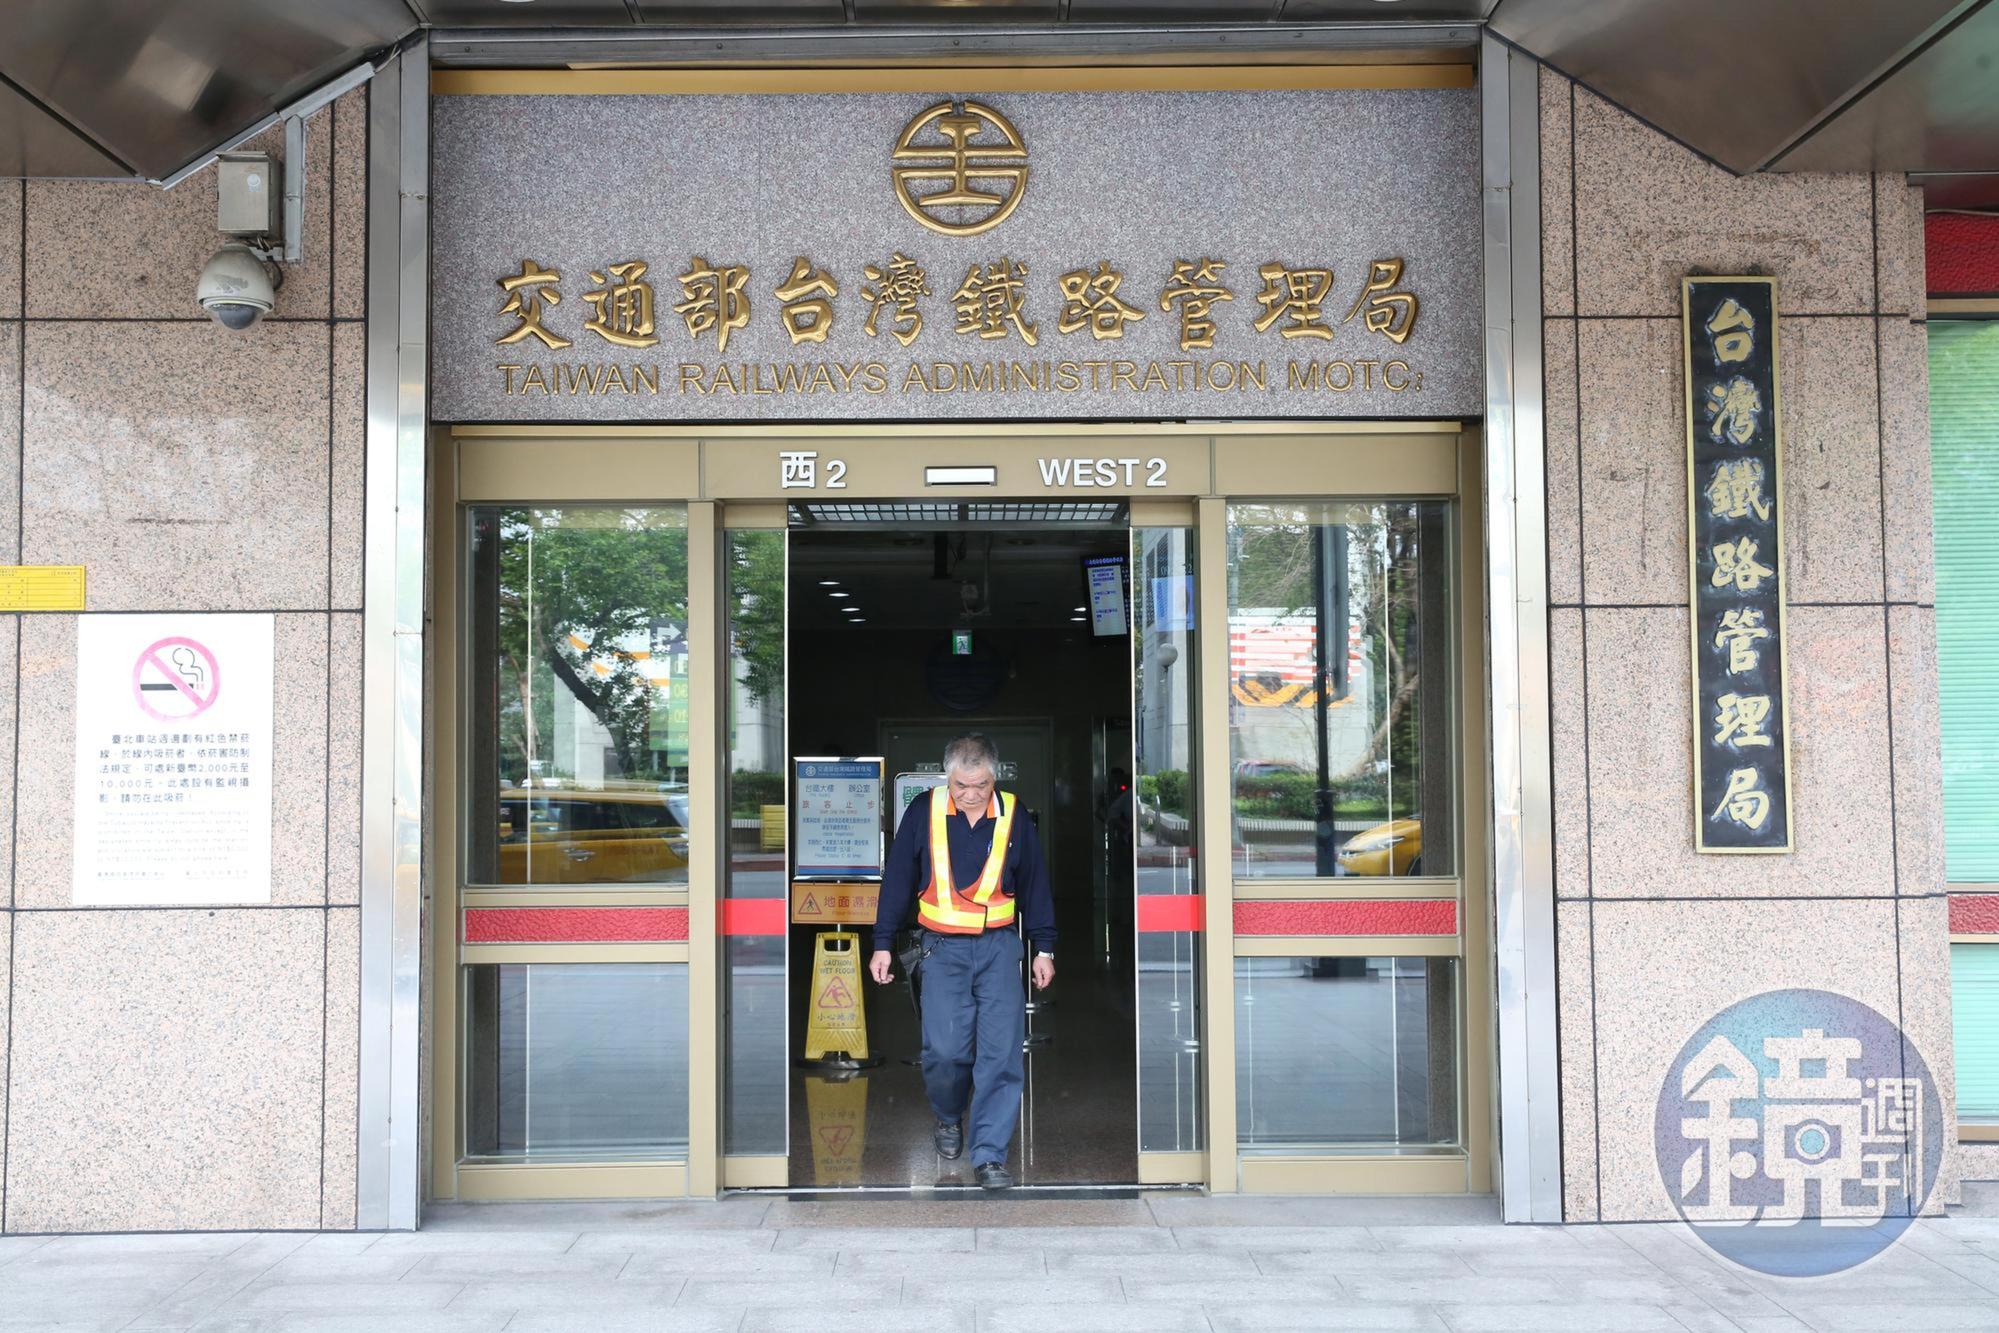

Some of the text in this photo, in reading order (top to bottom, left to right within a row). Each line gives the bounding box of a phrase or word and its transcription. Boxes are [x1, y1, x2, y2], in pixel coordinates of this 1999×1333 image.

[495, 252, 1420, 352] 交通部台灣鐵路管理局
[497, 363, 659, 395] TAIWAN
[678, 363, 889, 395] RAILWAYS
[902, 360, 1268, 393] ADMINISTRATION
[779, 451, 848, 489] 西 2
[1037, 457, 1168, 487] WEST 2
[1705, 297, 1774, 830] 台灣鐵路管理局
